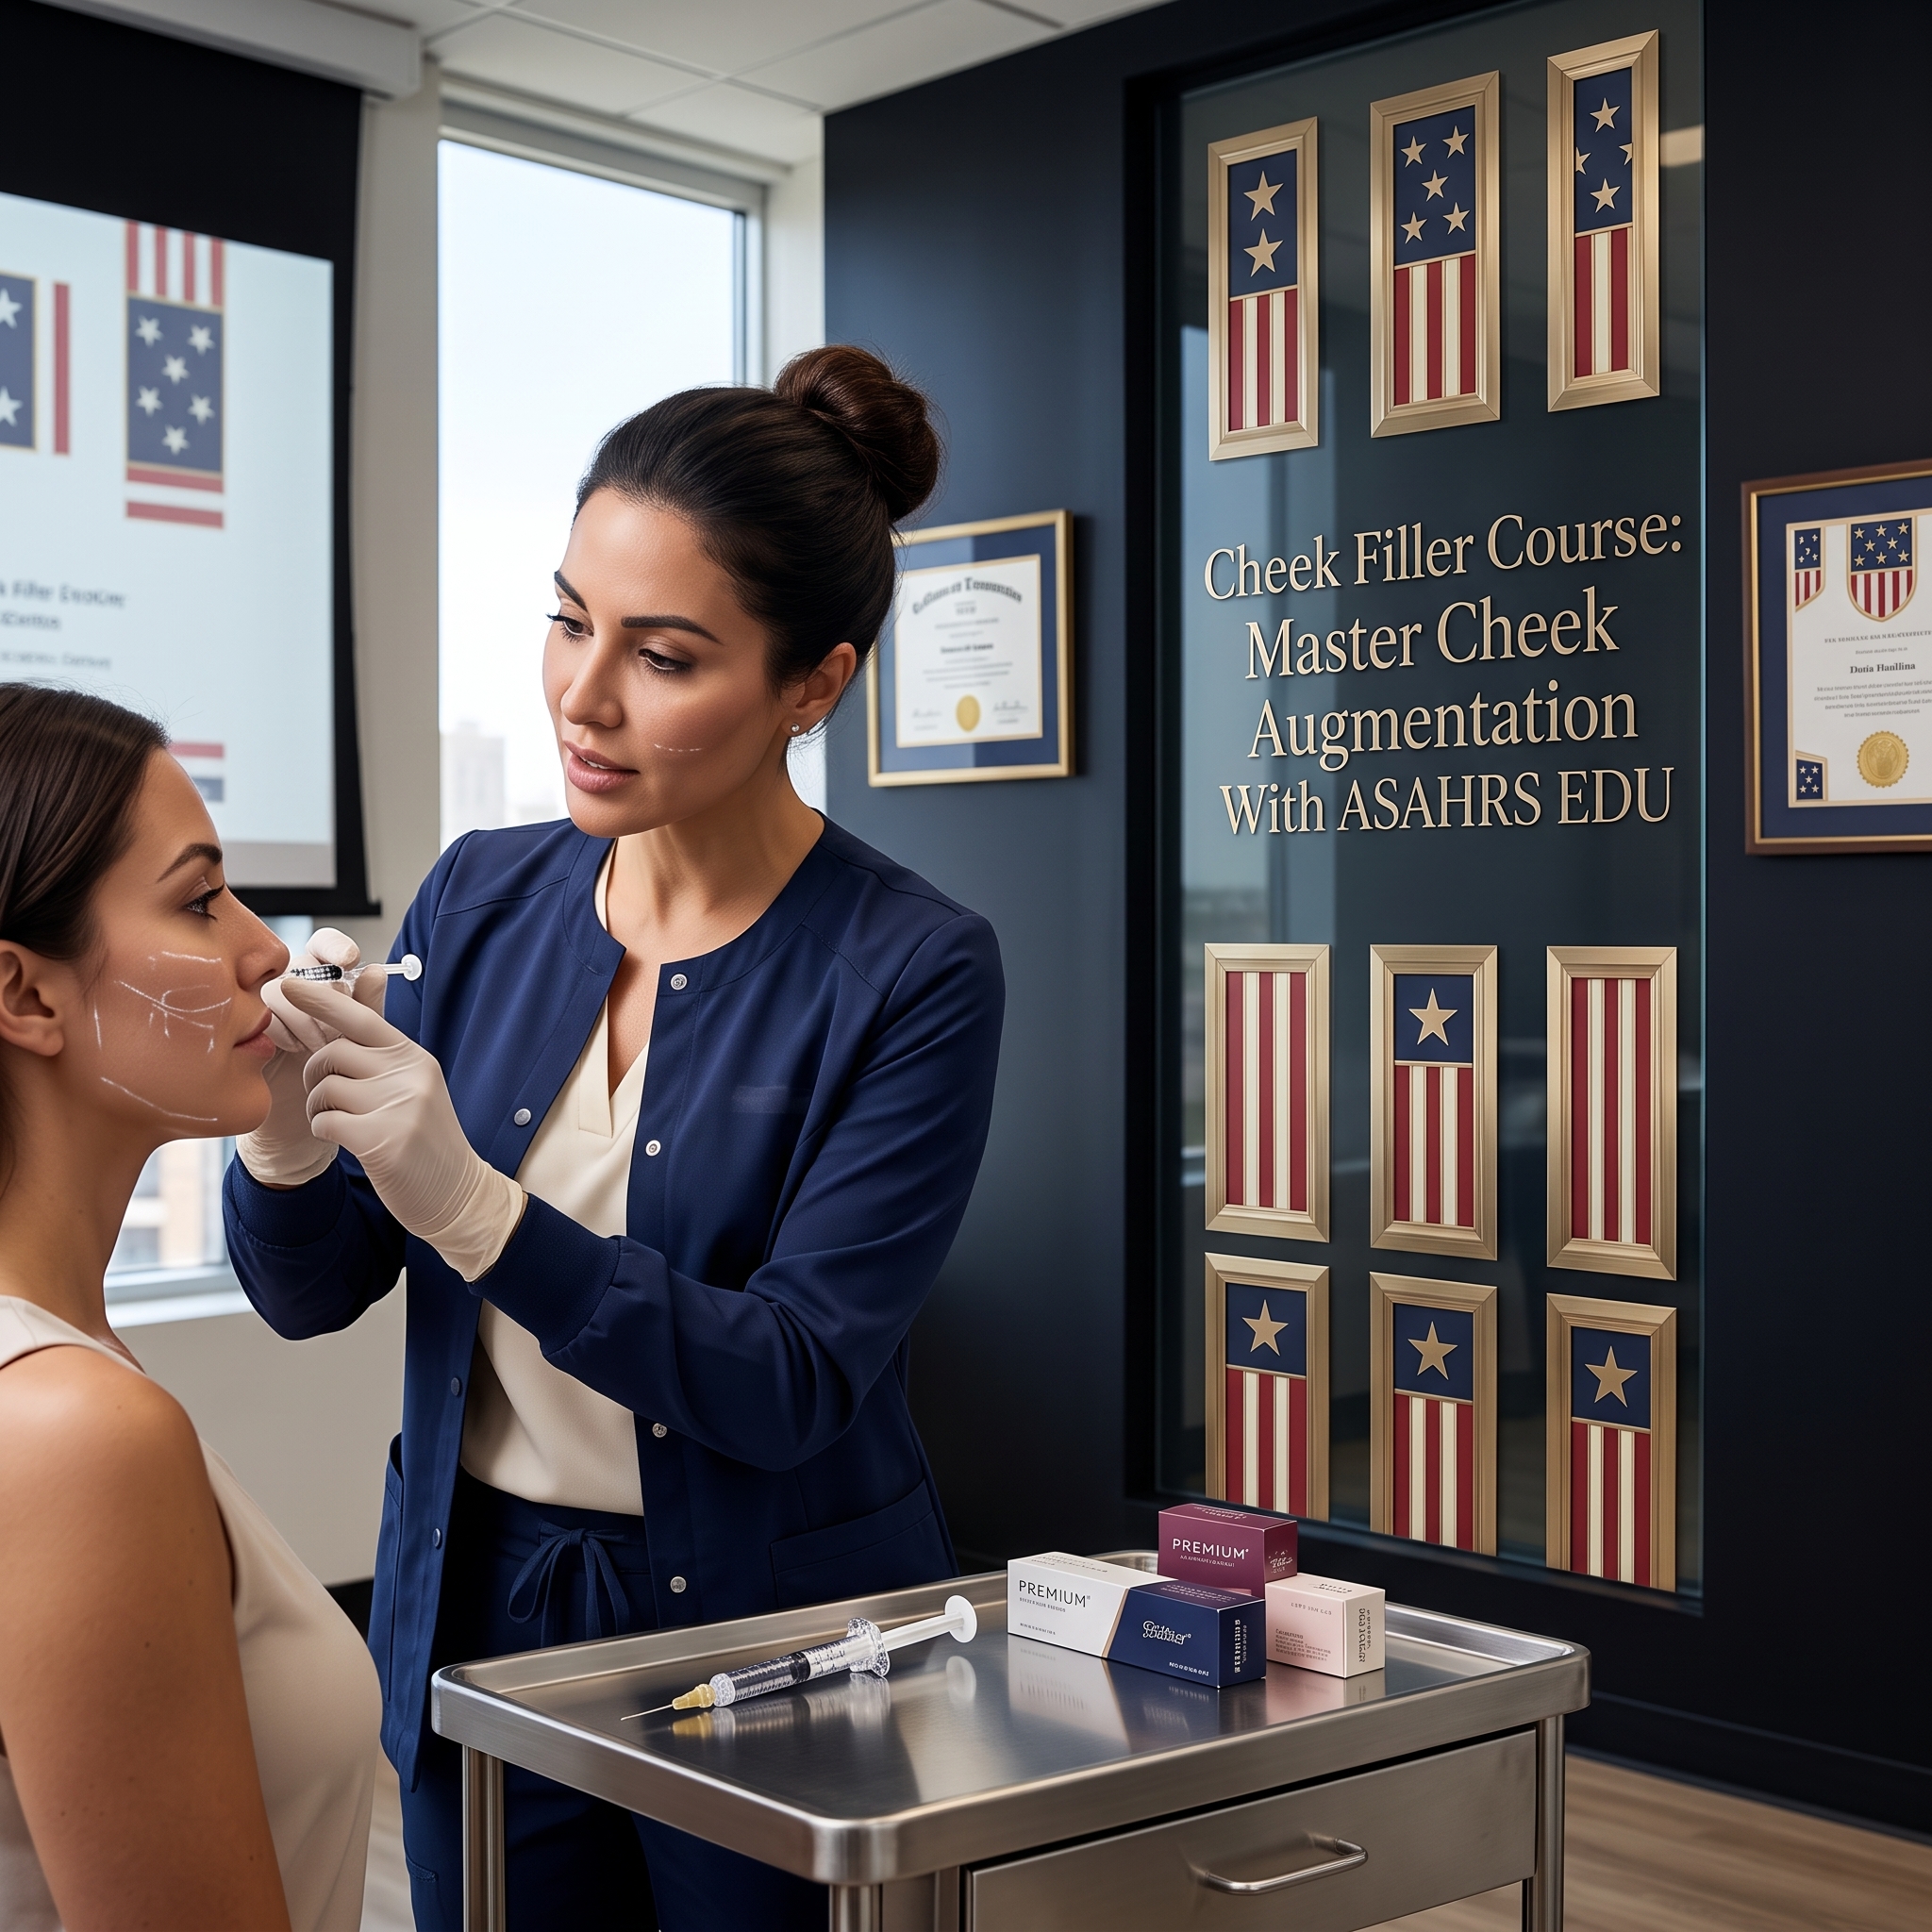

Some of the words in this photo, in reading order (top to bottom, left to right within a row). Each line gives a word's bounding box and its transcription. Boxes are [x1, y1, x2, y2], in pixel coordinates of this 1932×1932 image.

[1204, 533, 1341, 600] Cheek
[1354, 522, 1474, 586] Filler
[1487, 513, 1683, 570] Course:
[1244, 618, 1423, 679] Master
[1436, 585, 1620, 664] Cheek
[1247, 679, 1640, 773] Augmentation
[1219, 779, 1325, 835] With
[1337, 771, 1541, 832] ASAHRS
[1557, 766, 1674, 824] EDU
[1172, 1538, 1245, 1560] PREMIUM
[1019, 1579, 1087, 1608] PREMIUM
